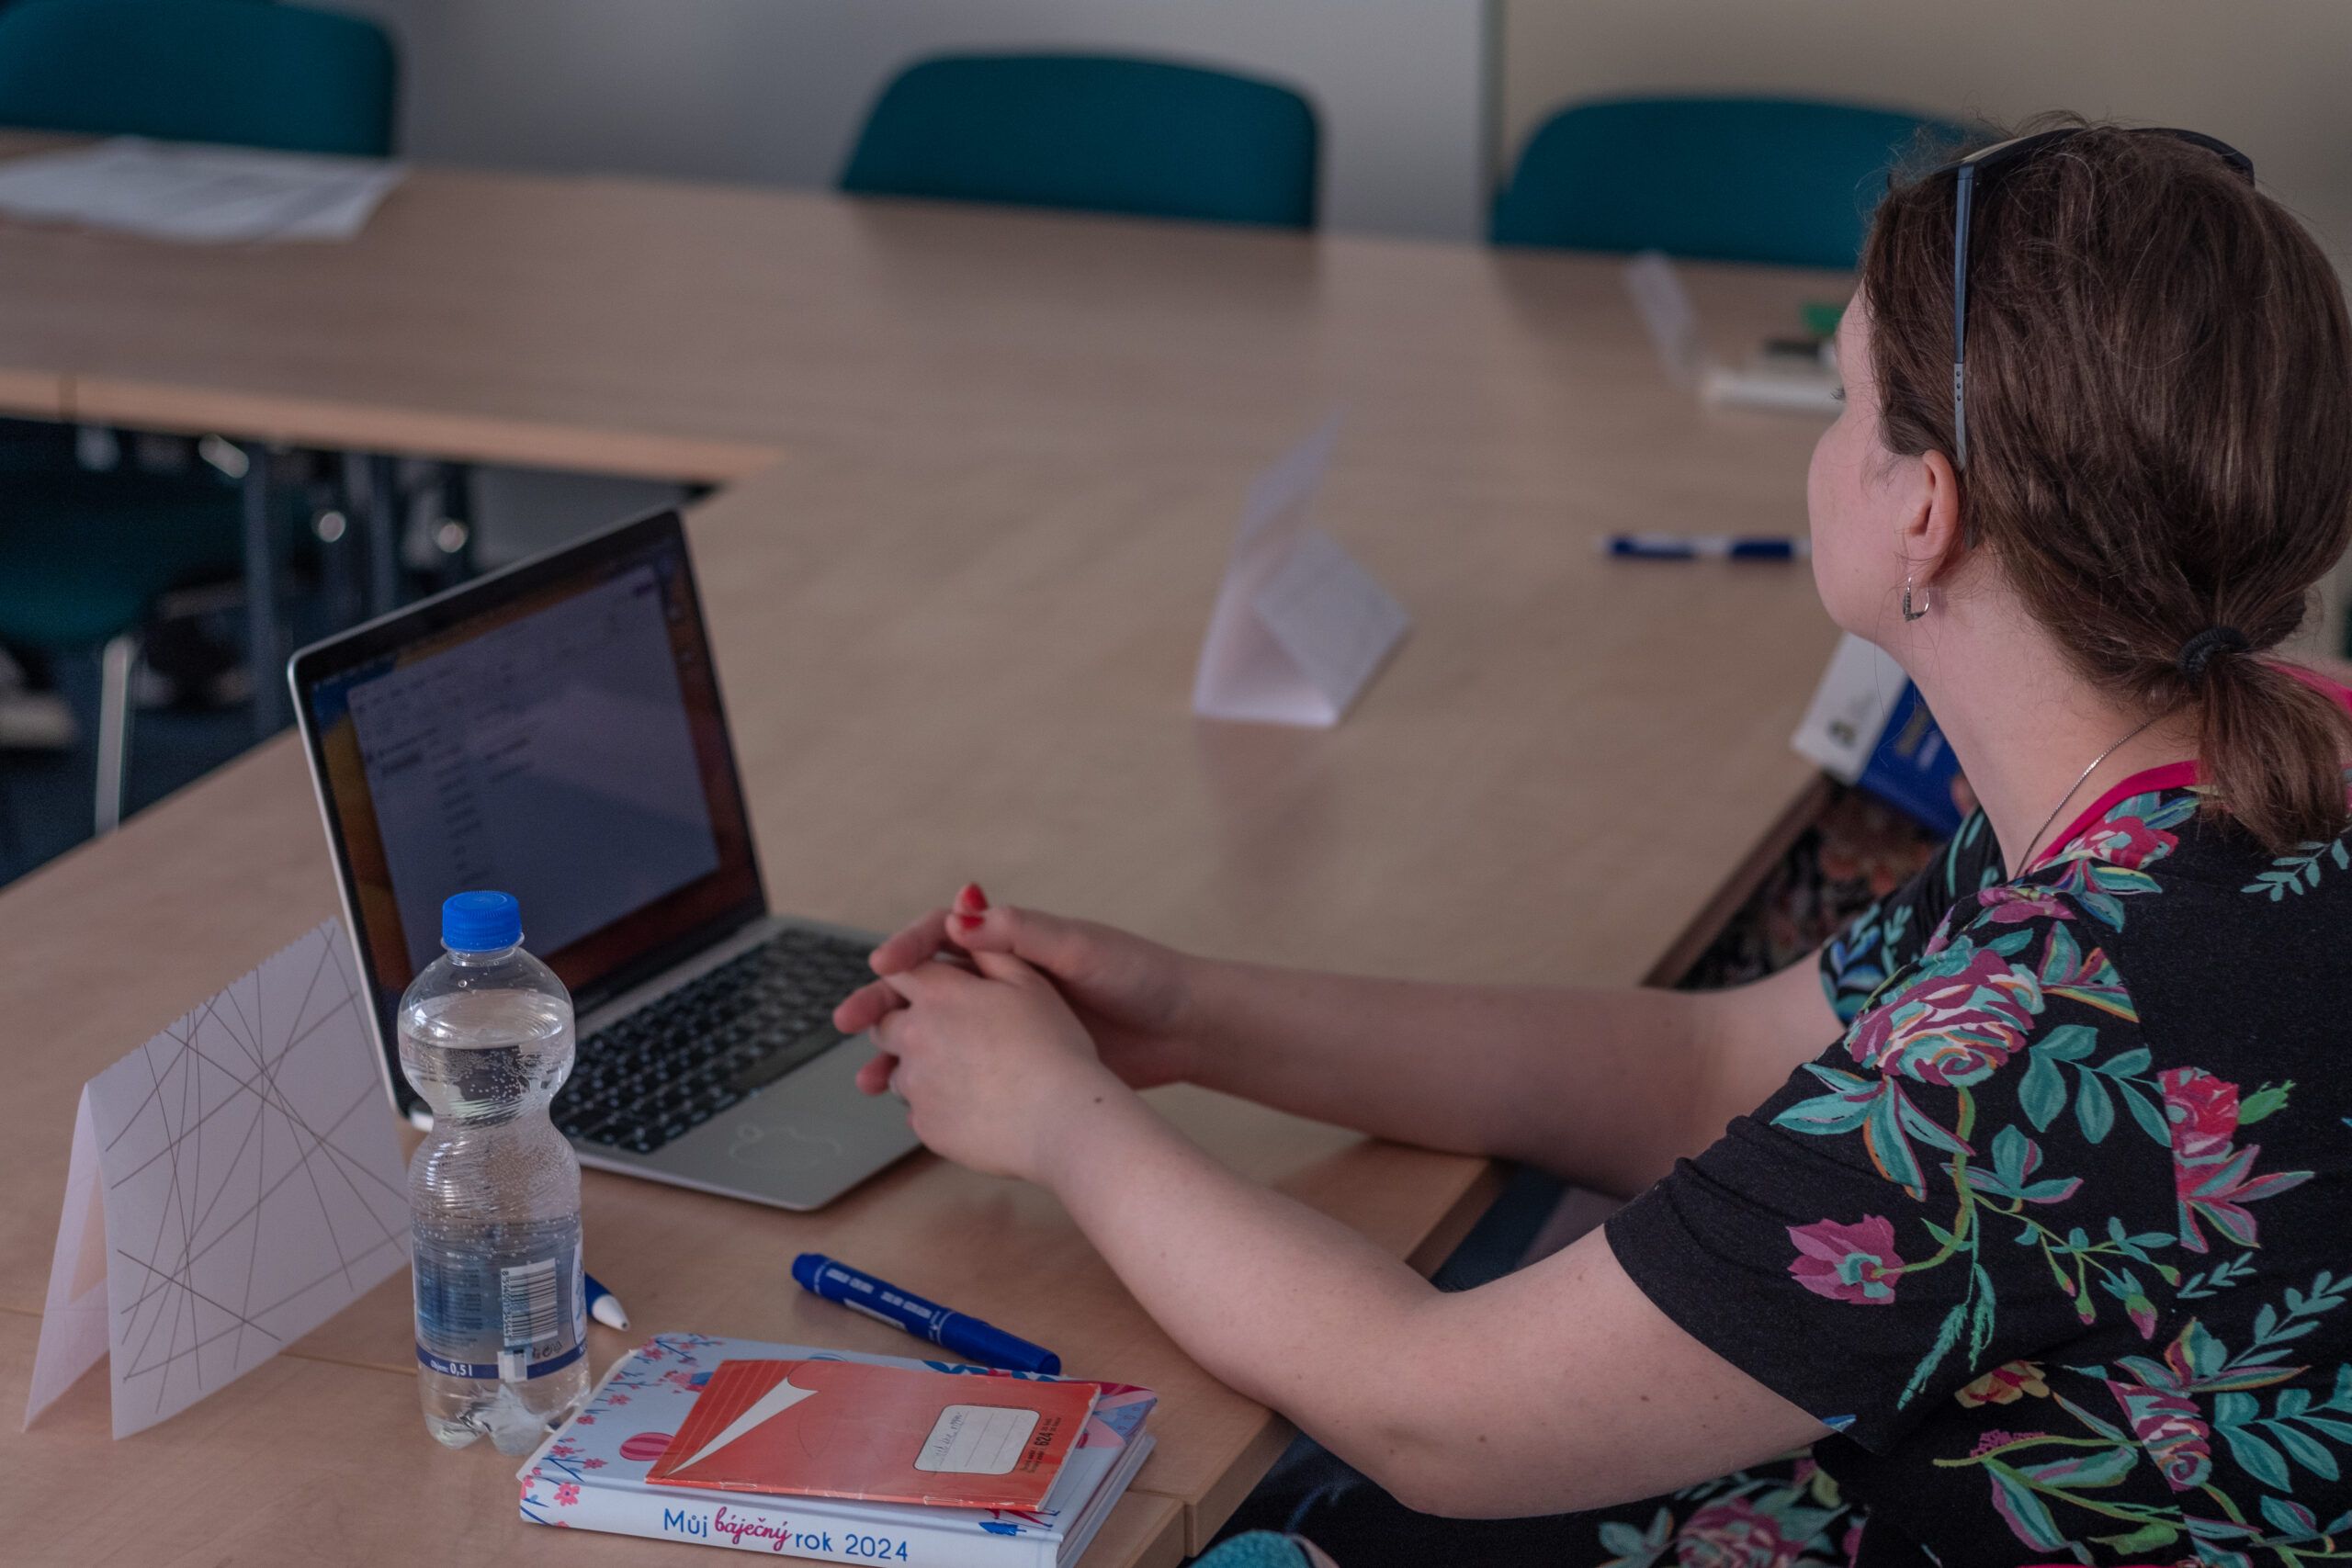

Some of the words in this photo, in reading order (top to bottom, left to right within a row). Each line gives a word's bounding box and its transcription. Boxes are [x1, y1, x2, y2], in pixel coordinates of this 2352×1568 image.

[1035, 1432, 1054, 1446] 624
[663, 1507, 707, 1539] Můj
[714, 1506, 792, 1551] báječný
[796, 1531, 833, 1552] rok
[845, 1533, 908, 1562] 2024
